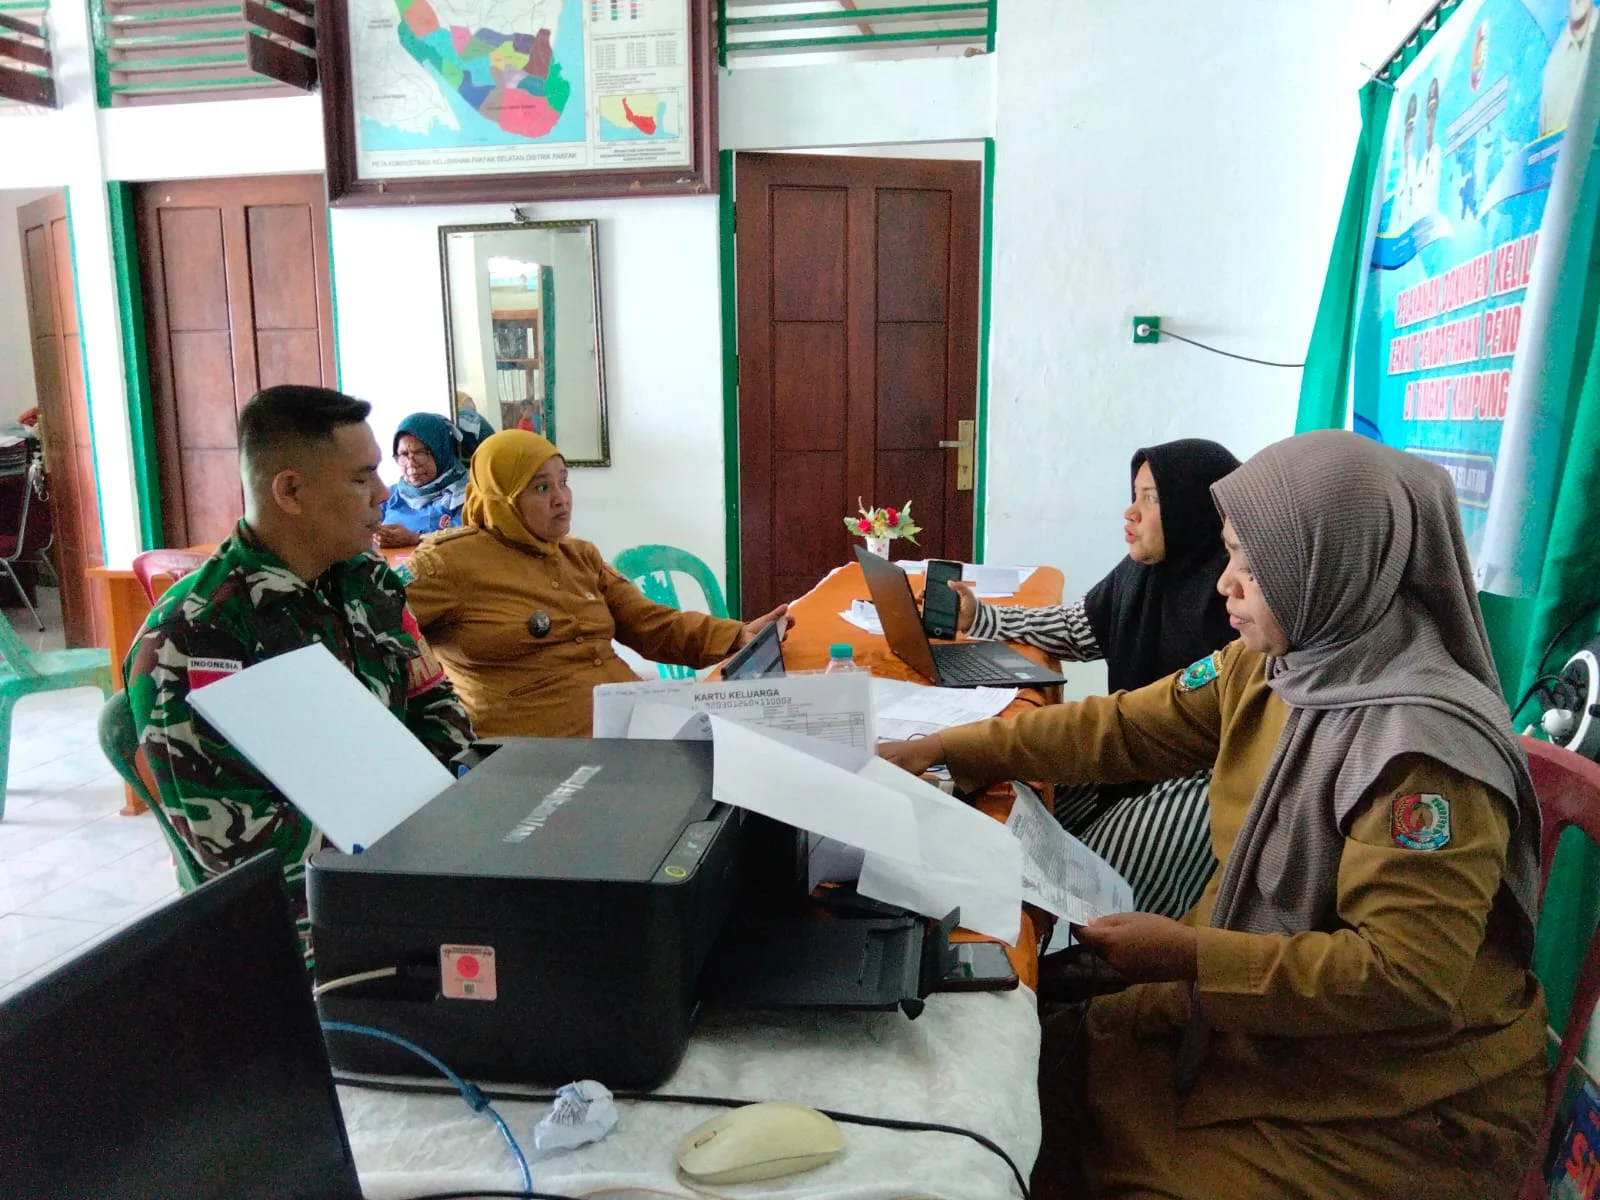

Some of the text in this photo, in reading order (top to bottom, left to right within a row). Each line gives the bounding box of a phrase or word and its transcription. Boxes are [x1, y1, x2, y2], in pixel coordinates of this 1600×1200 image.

[1451, 370, 1510, 419] KAMPUNG
[191, 661, 239, 669] INDONESIA
[694, 689, 780, 702] KARTU KELUARGA
